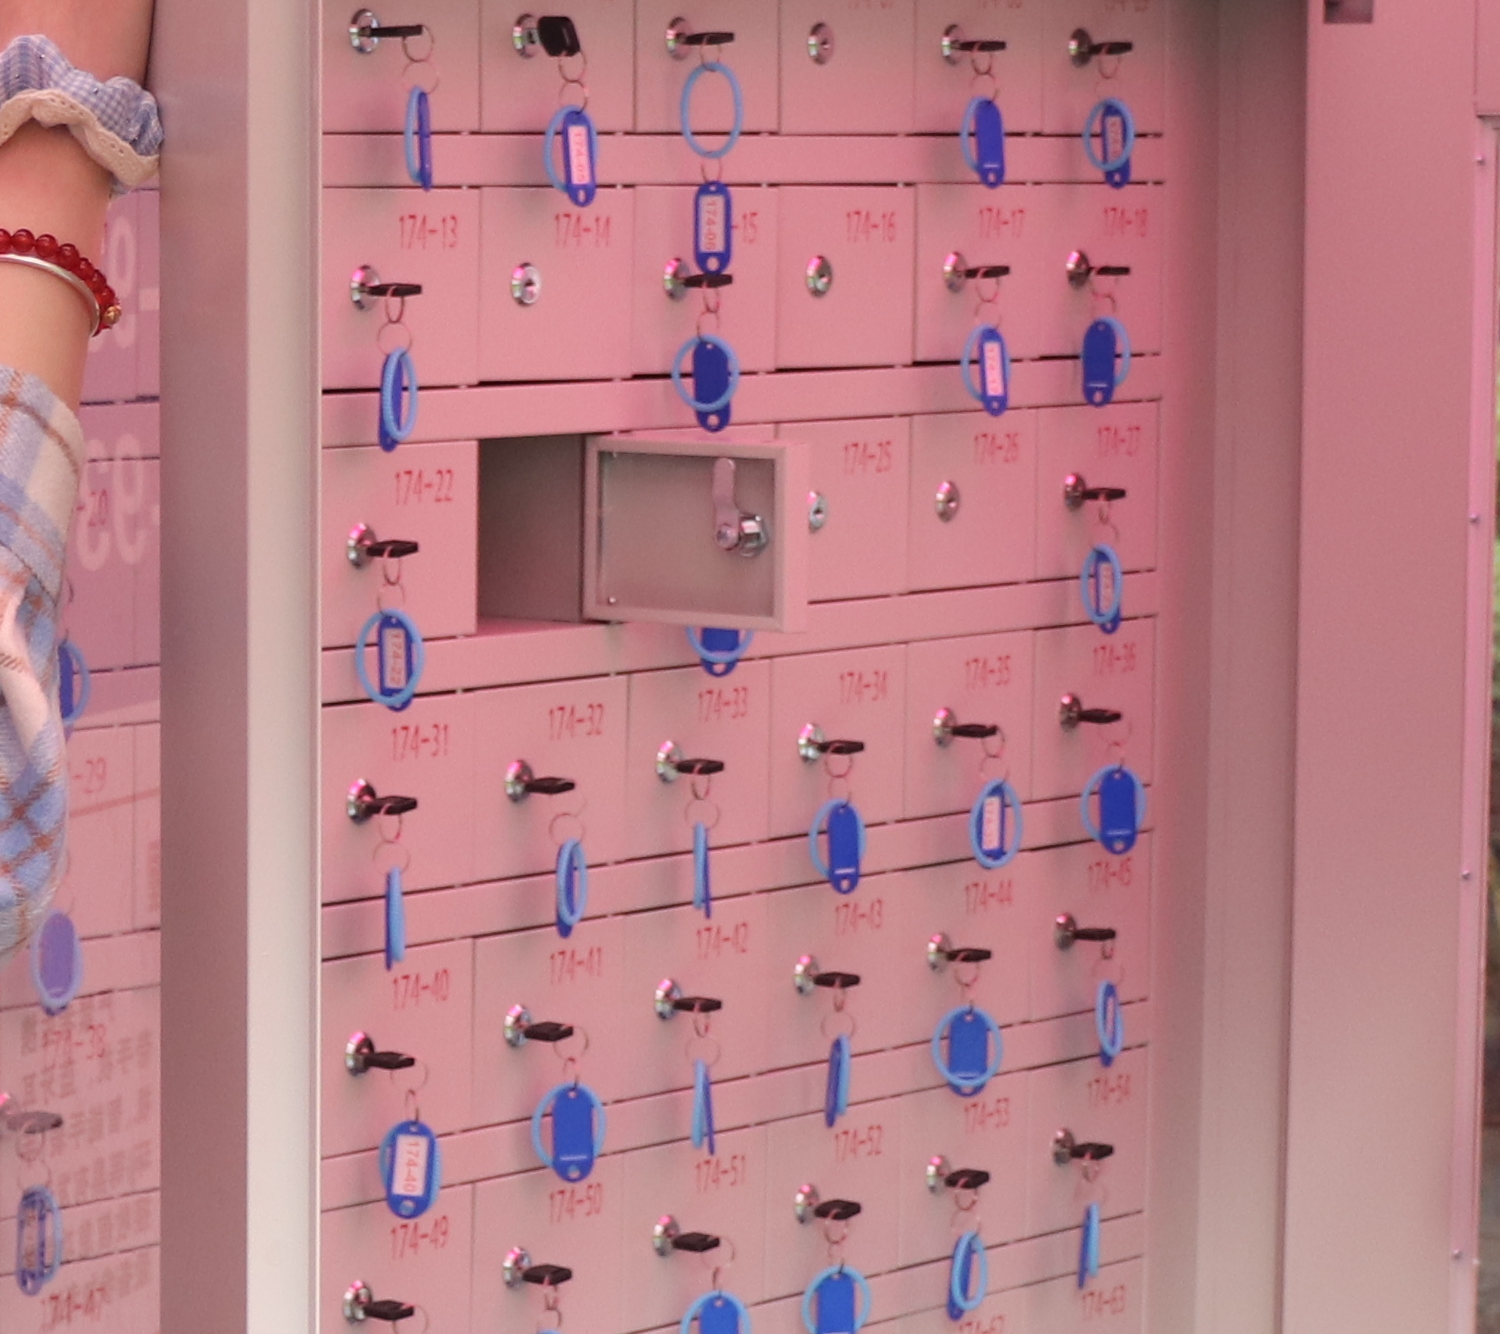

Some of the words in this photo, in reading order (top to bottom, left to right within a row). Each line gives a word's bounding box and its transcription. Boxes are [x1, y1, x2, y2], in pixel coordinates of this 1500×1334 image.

[399, 214, 458, 249] 174-13
[555, 213, 611, 247] 174-14
[395, 469, 454, 505] 174-22
[550, 703, 604, 740] 174-32
[699, 687, 748, 723] 174-33
[392, 724, 449, 761] 174-31
[696, 922, 748, 959] 174-42
[551, 947, 604, 983] 174-41
[393, 969, 449, 1009] 174-40
[695, 1155, 746, 1192] 174-51
[550, 1182, 604, 1222] 174-50
[391, 1216, 448, 1258] 174-49
